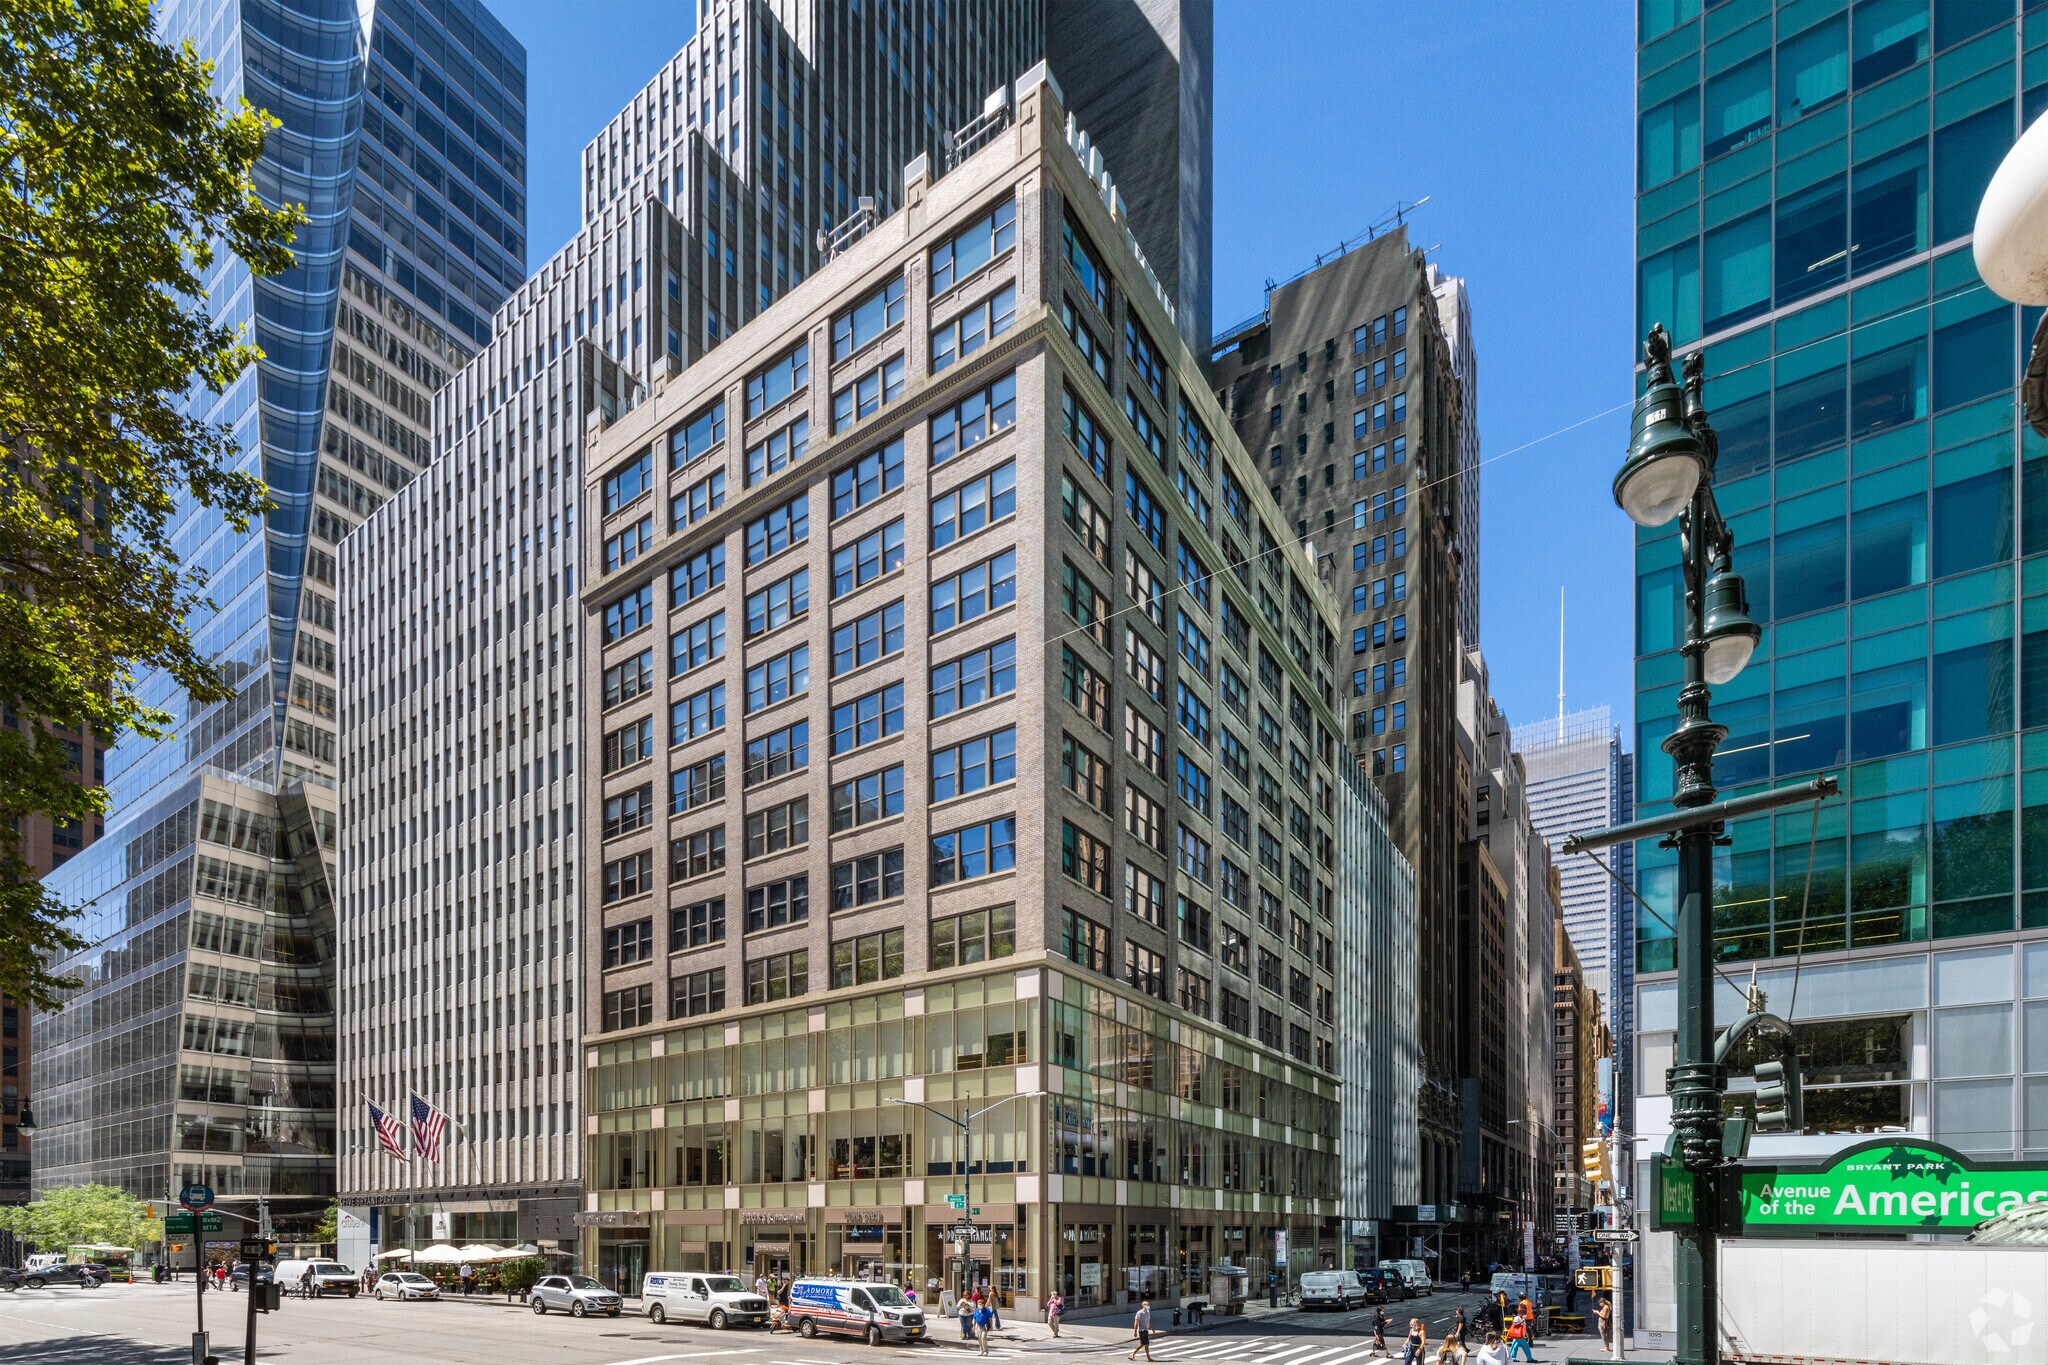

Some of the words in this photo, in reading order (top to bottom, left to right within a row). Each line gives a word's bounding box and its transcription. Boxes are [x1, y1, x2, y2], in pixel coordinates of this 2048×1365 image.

[1847, 1164, 1901, 1172] BRYANT
[1907, 1163, 1946, 1171] PARK
[1663, 1177, 1677, 1212] West
[1687, 1183, 1693, 1213] St
[1759, 1184, 1831, 1198] Avenue
[1759, 1200, 1779, 1215] of
[1784, 1200, 1815, 1215] the
[342, 1216, 368, 1228] citibank
[741, 1212, 766, 1221] BOOKS
[805, 1286, 834, 1296] ADMORE
